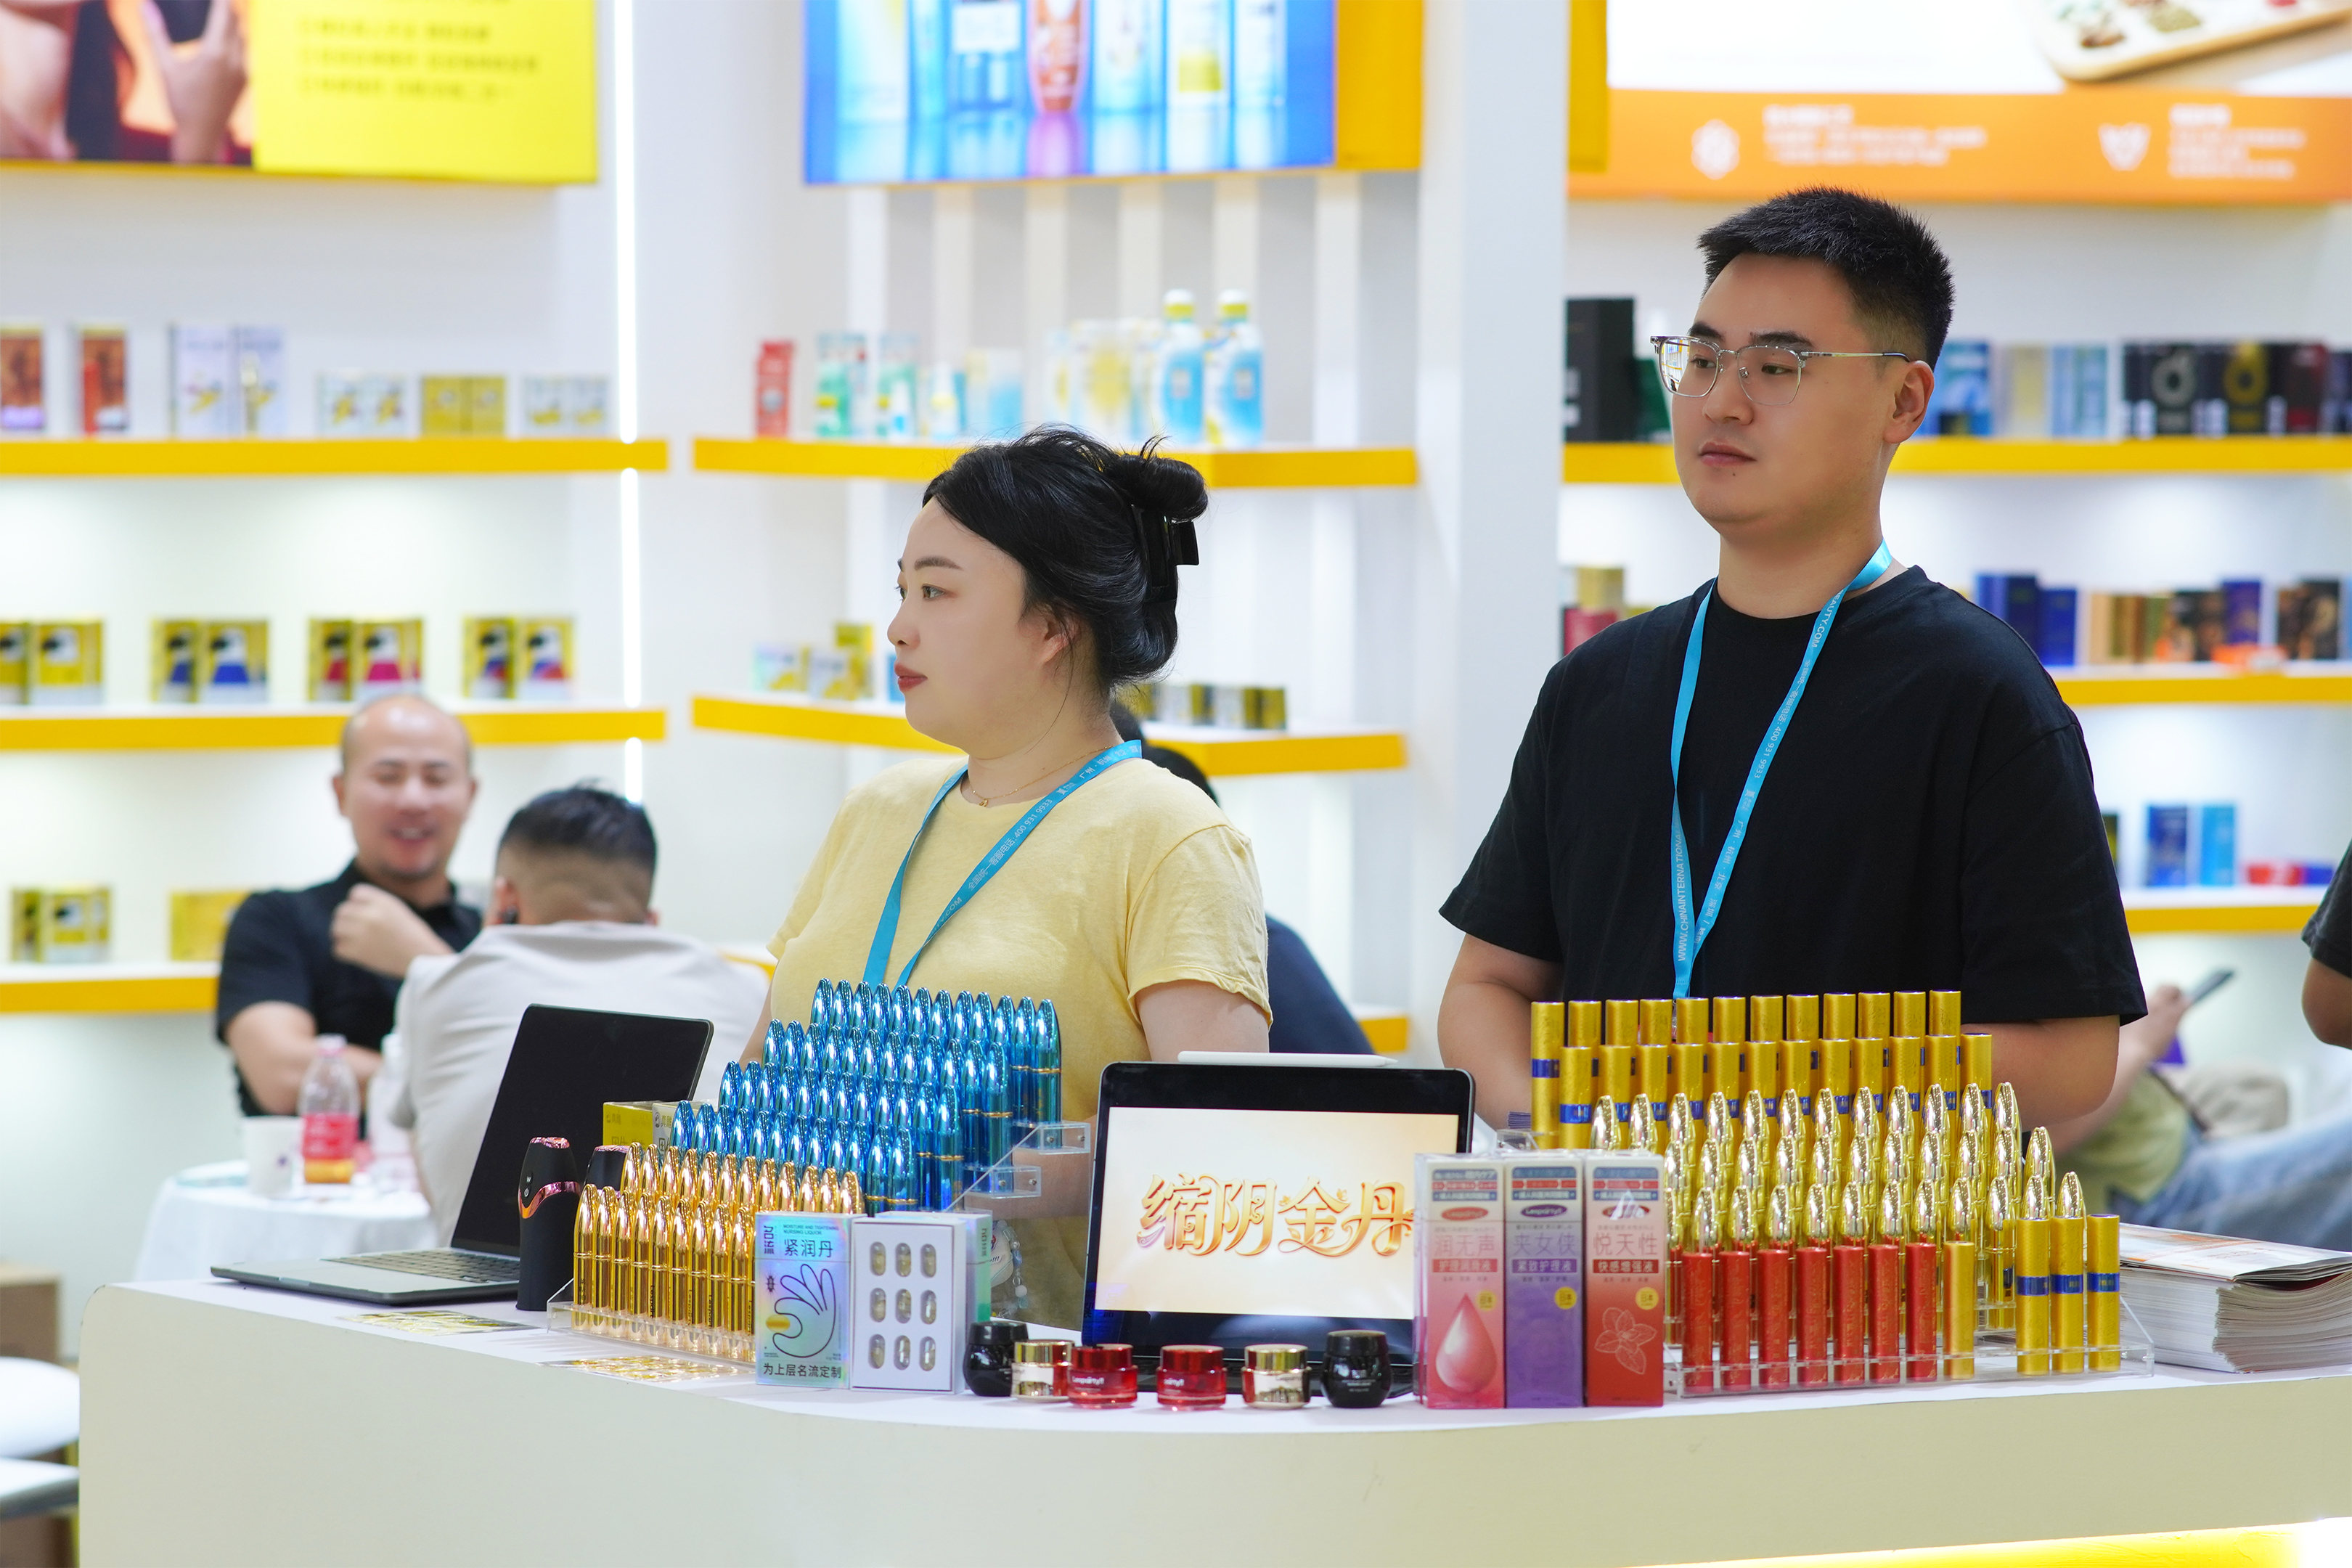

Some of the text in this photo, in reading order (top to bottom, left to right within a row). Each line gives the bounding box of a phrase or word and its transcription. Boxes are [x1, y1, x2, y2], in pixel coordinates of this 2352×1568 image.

[1763, 743, 1775, 756] 931
[1754, 759, 1768, 779] 9933
[1024, 813, 1037, 826] 931
[1036, 799, 1053, 814] 9933
[1136, 1172, 1414, 1257] 缩阴金丹
[784, 1238, 833, 1258] 紧润丹
[1434, 1234, 1495, 1257] 润无声
[1512, 1232, 1576, 1256] 夹女侠
[1593, 1232, 1657, 1256] 悦天性
[764, 1363, 841, 1379] 为上层名流定制
